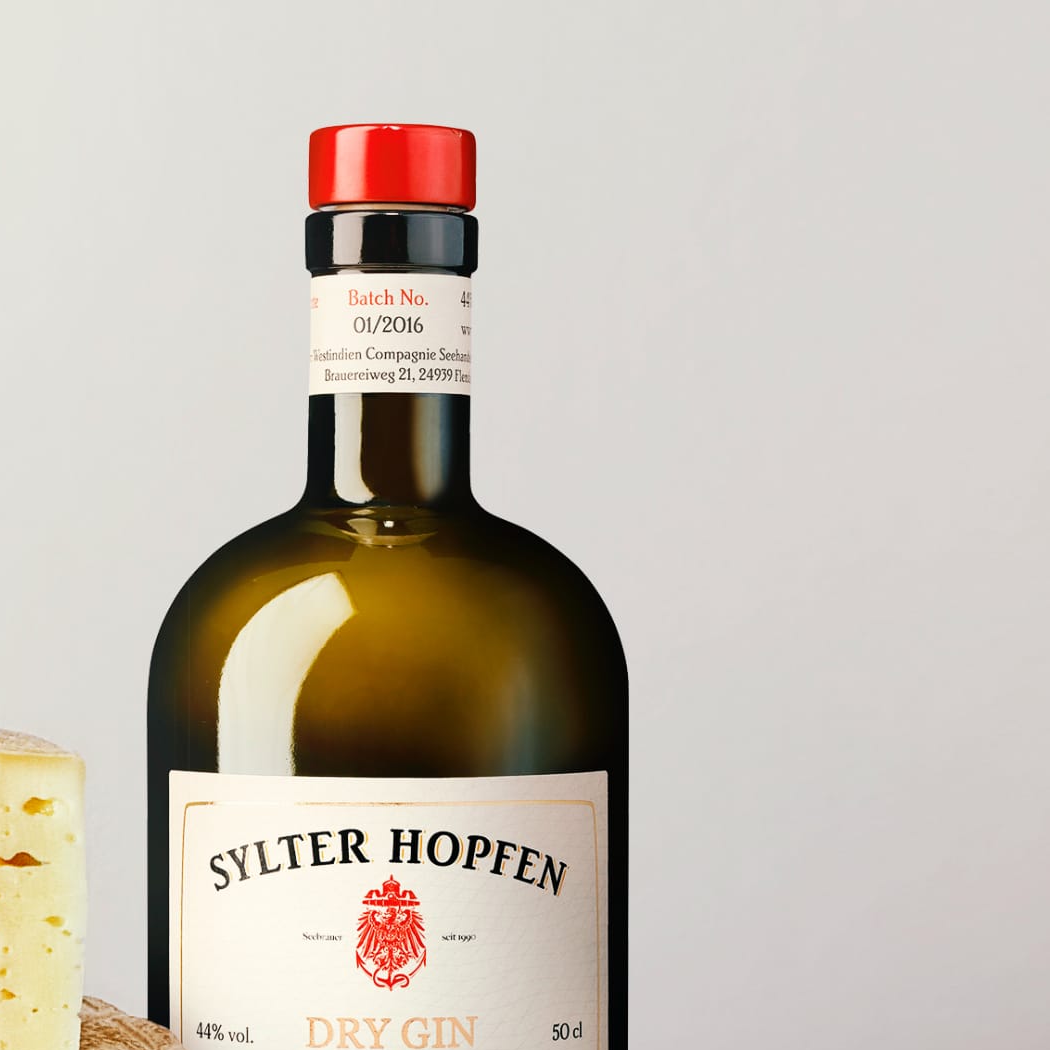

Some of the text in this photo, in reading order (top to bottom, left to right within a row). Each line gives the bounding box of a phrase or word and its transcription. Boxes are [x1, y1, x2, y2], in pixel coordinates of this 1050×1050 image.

[348, 288, 429, 306] Batch No.
[353, 314, 424, 335] 01/2016
[365, 346, 437, 363] Compagnie
[325, 368, 395, 384] Brauereiweg
[399, 367, 416, 383] 21,
[419, 367, 453, 382] 24939
[209, 828, 569, 896] SYLTER HOPFEN
[441, 933, 457, 942] seit
[196, 1022, 254, 1044] 44% vol.
[305, 1015, 478, 1049] DRY GIN
[552, 1021, 583, 1041] 50 cl
